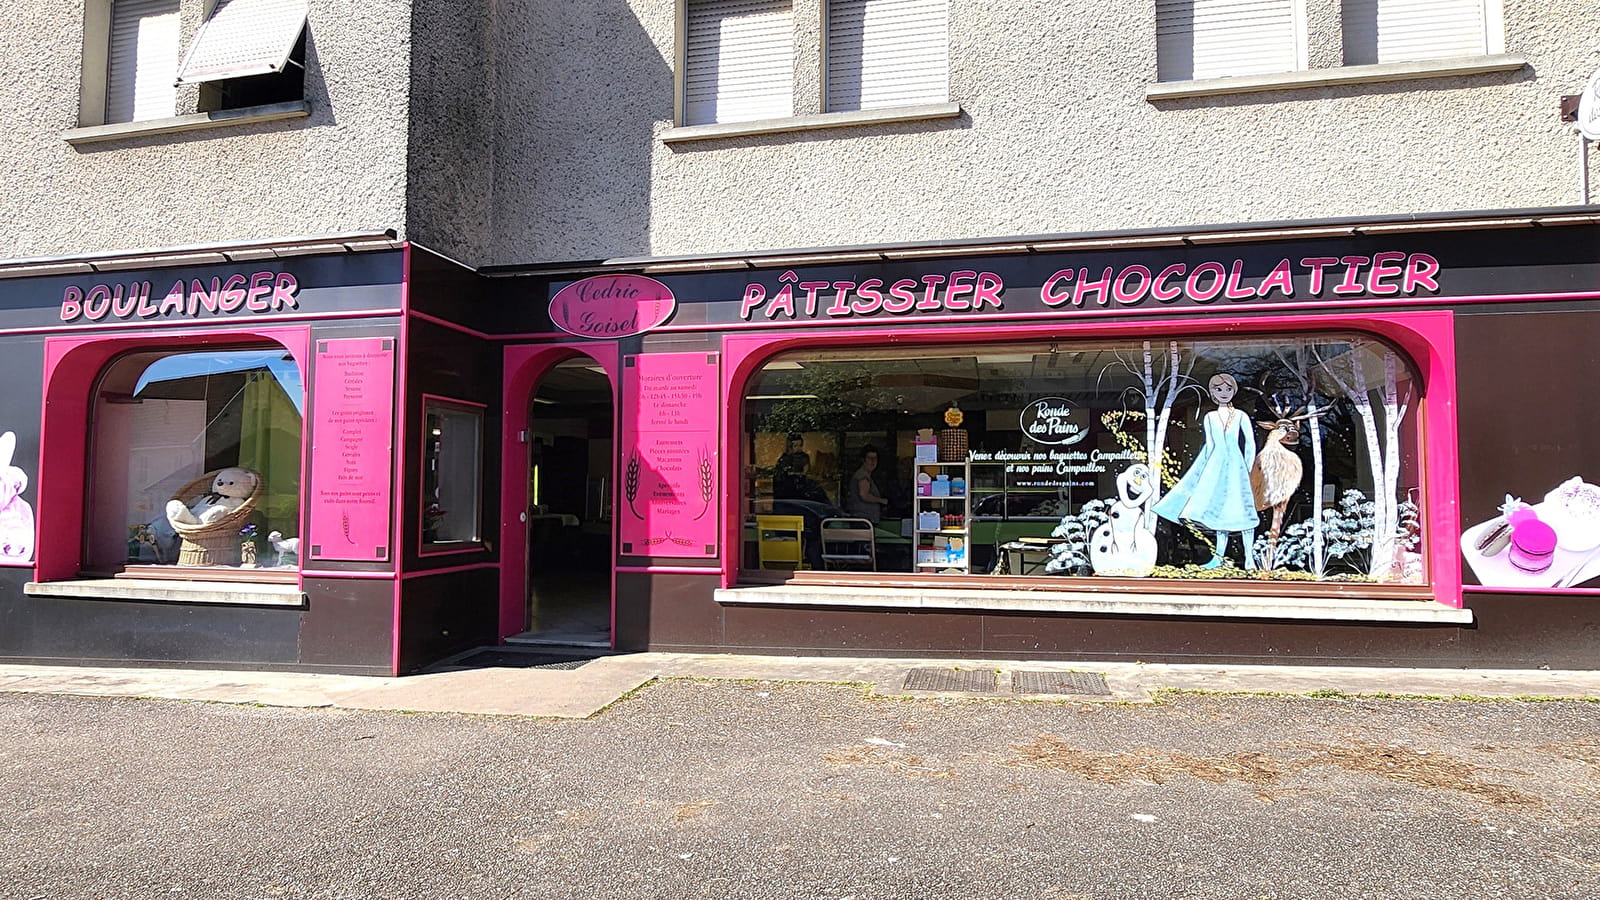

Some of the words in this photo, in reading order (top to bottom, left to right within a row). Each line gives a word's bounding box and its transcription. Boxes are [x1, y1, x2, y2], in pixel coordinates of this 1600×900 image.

[575, 280, 639, 303] Cedric
[739, 269, 1004, 319] PÂTISSIER
[1040, 251, 1441, 308] CHOCOLATIER
[60, 271, 297, 321] BOULANGER
[580, 309, 638, 333] Goisel
[1036, 402, 1070, 419] Ronde
[1029, 420, 1047, 434] des
[1048, 417, 1078, 435] Pains
[968, 450, 992, 462] Venez
[994, 450, 1031, 461] découvrir
[1033, 452, 1047, 460] nos
[1050, 450, 1088, 463] baguettes
[1006, 464, 1014, 472] et
[1016, 465, 1030, 473] nos
[1032, 464, 1054, 477] pains
[1056, 463, 1106, 476] Campaillou
